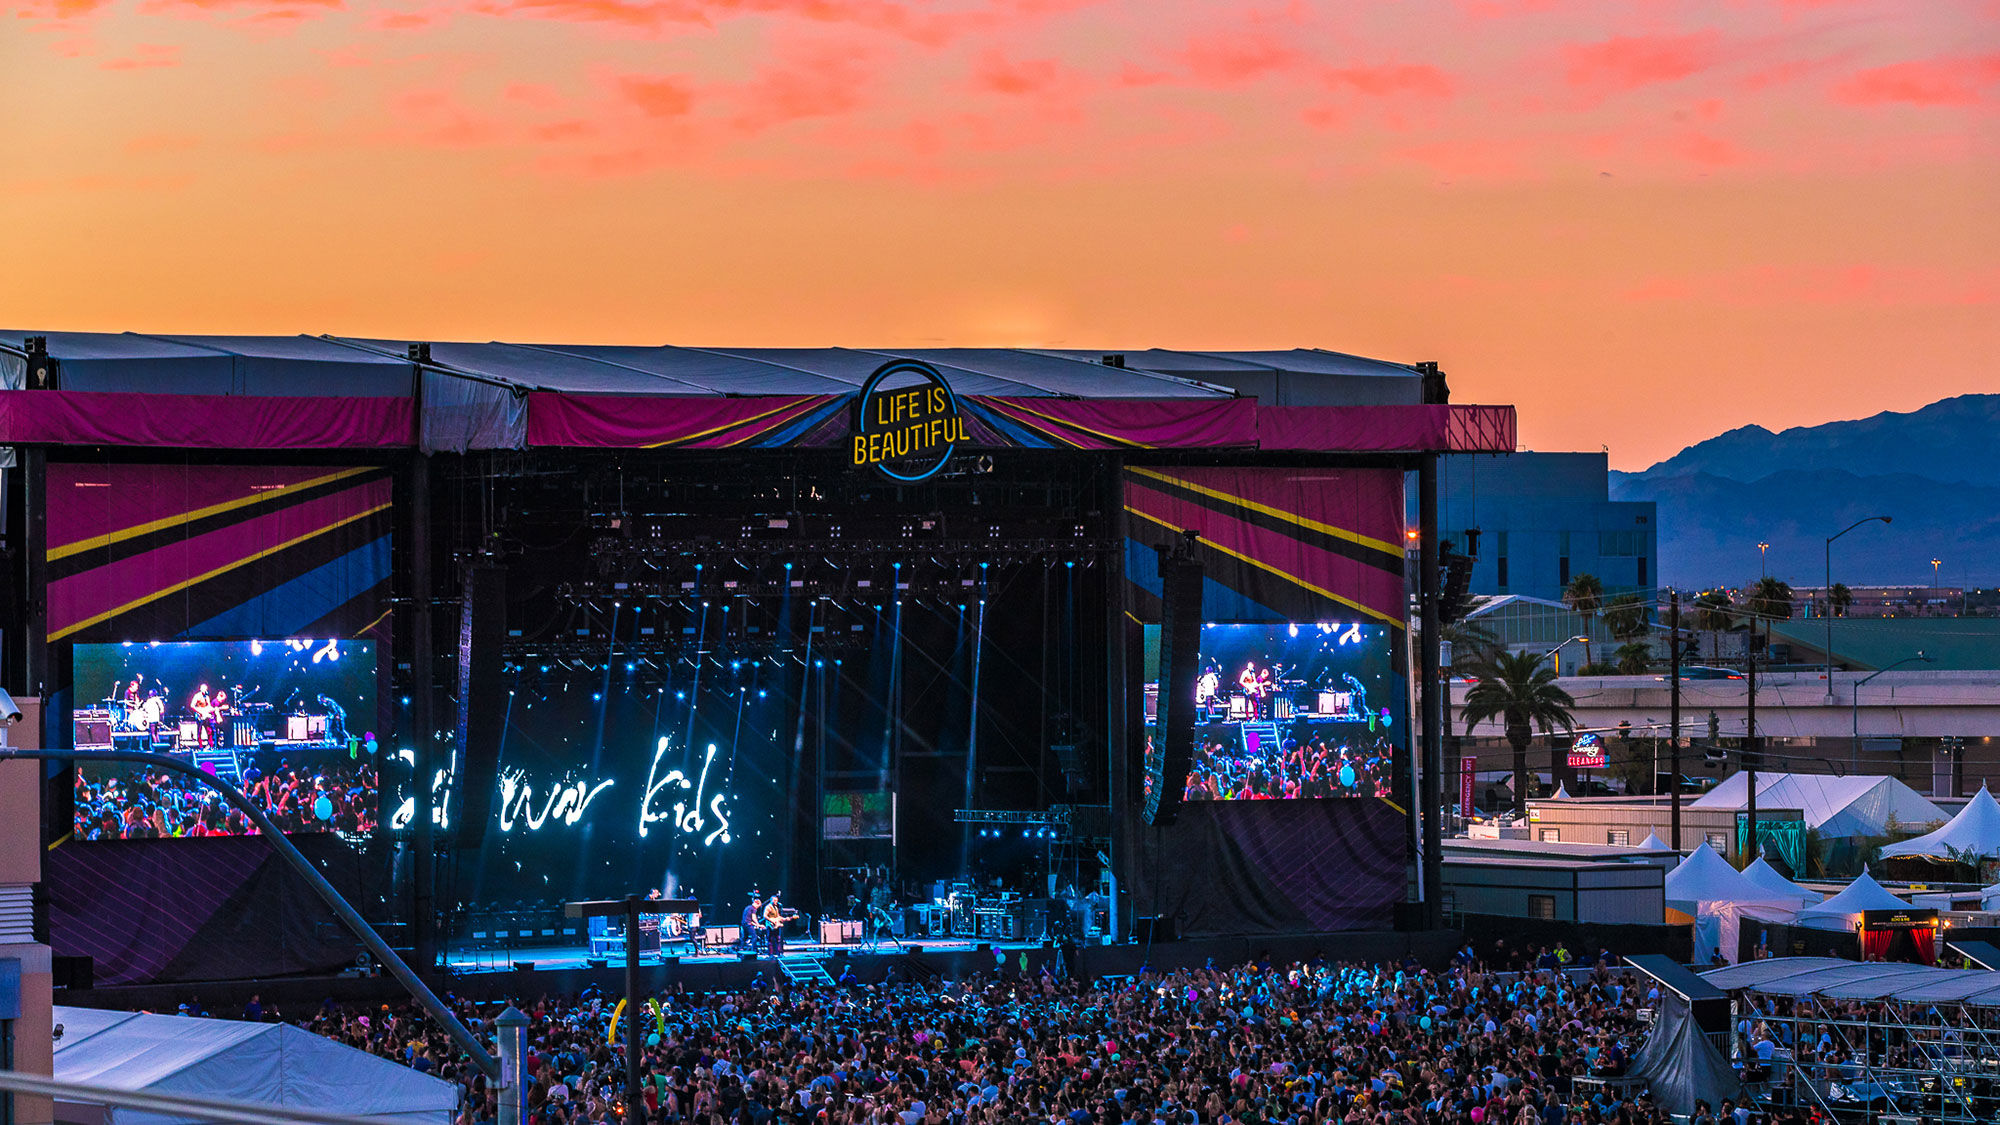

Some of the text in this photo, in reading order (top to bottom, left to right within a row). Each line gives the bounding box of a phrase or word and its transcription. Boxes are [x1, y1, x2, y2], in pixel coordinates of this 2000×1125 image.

[878, 387, 946, 425] LIFE IS
[854, 416, 970, 465] BEAUTIFUL
[1568, 756, 1605, 767] CLEANERS
